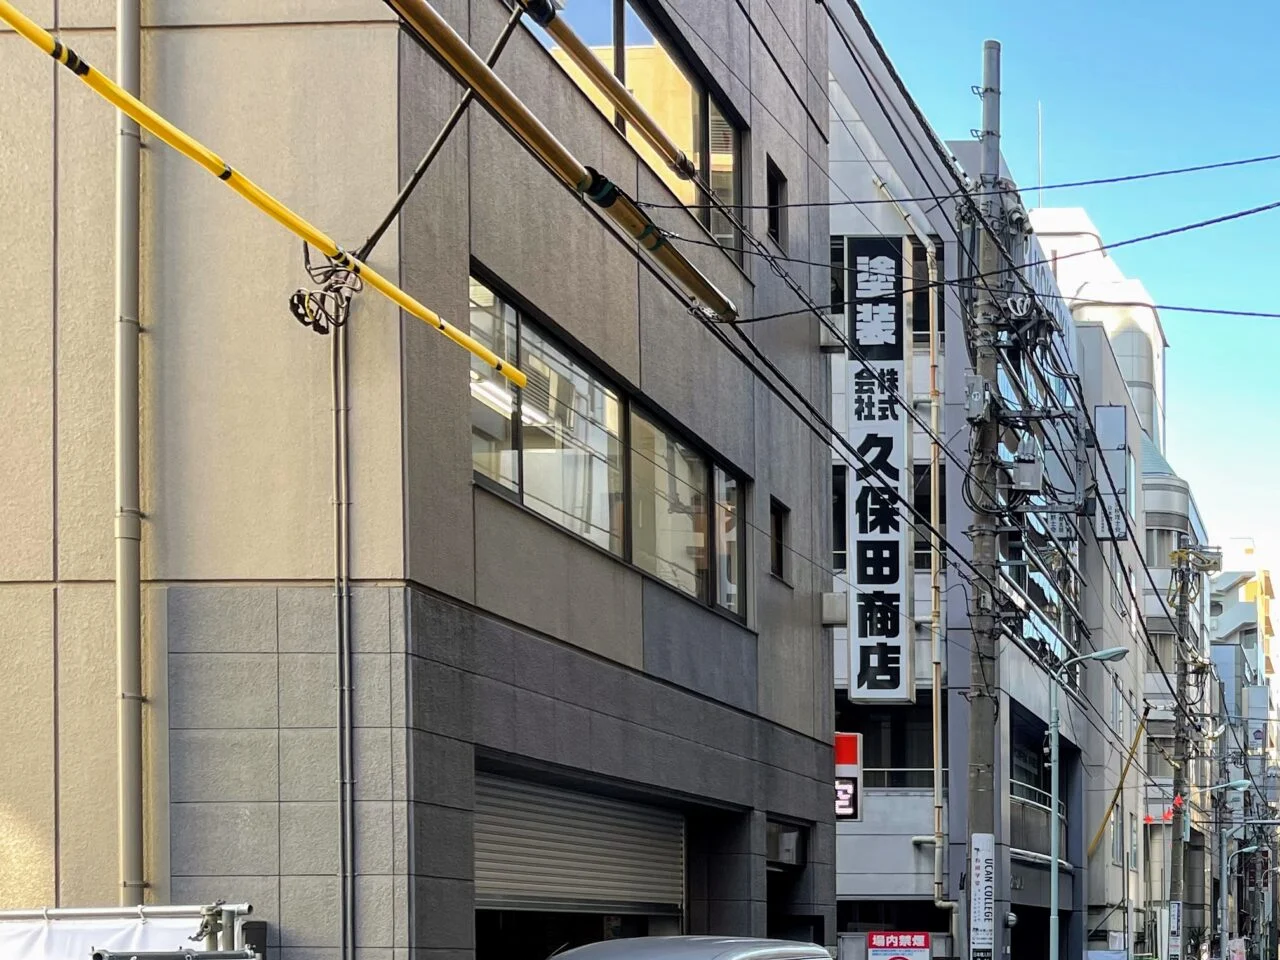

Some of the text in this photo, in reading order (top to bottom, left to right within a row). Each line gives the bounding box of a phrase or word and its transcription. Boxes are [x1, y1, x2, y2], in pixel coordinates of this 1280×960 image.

[856, 255, 896, 346] 塗装
[855, 433, 901, 690] 久保田商店
[984, 858, 993, 922] UCAN COLLEGE
[872, 934, 926, 947] 場内禁煙
